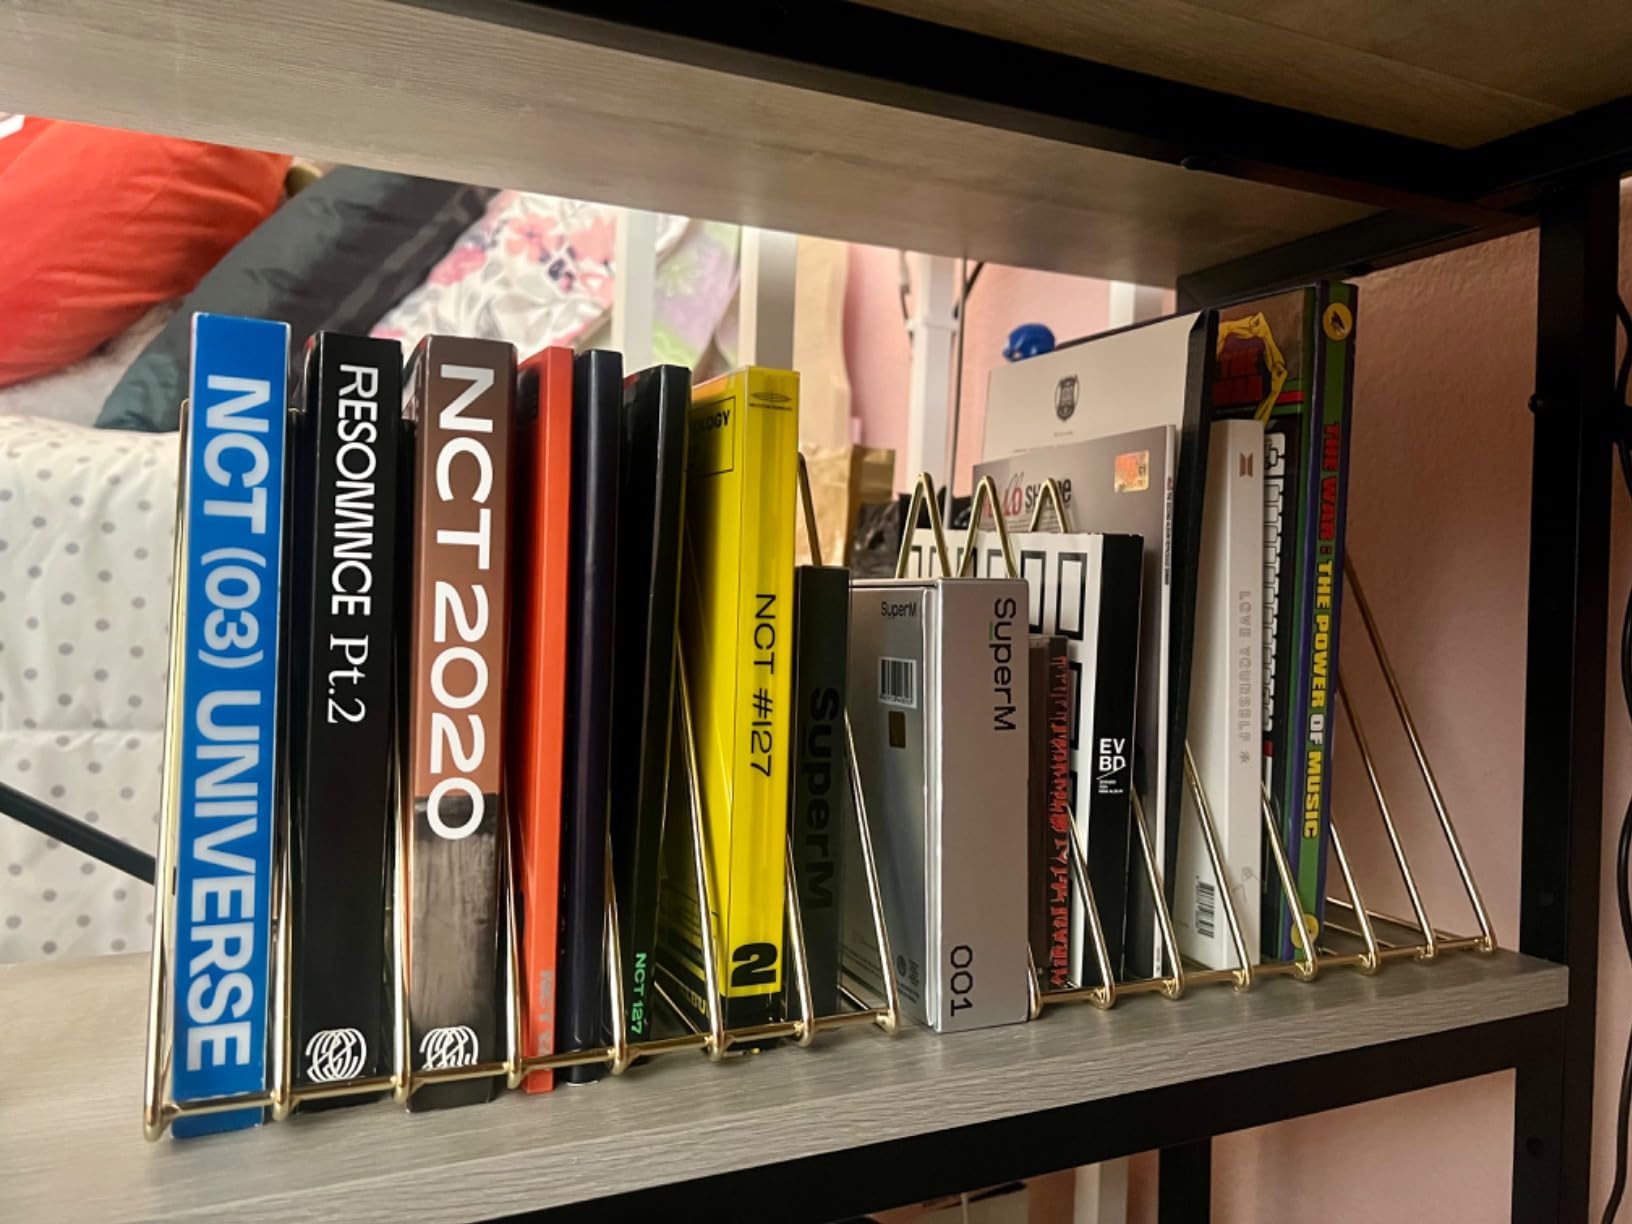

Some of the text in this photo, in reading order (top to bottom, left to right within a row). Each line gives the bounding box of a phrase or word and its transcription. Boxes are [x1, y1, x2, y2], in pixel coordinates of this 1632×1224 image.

[1323, 423, 1340, 472] THE
[1319, 475, 1337, 540] WAR
[426, 364, 495, 840] NCT 2020
[881, 601, 917, 619] SuperM
[1238, 590, 1252, 638] LOVE
[1316, 560, 1333, 609] THE
[327, 633, 369, 724] Pt.2
[750, 594, 777, 777] NCT #127
[989, 598, 1016, 731] SuperM
[1237, 647, 1251, 743] YOURSELF
[1311, 614, 1330, 708] POWER
[187, 374, 270, 1072] NCT (03) UNIVERSE
[1099, 738, 1126, 754] EV
[1309, 714, 1325, 746] OF
[804, 687, 840, 909] SuperM
[1304, 750, 1321, 838] MUSIC
[631, 953, 648, 1034] NCT 127
[731, 942, 778, 987] 2
[950, 945, 973, 1017] 001
